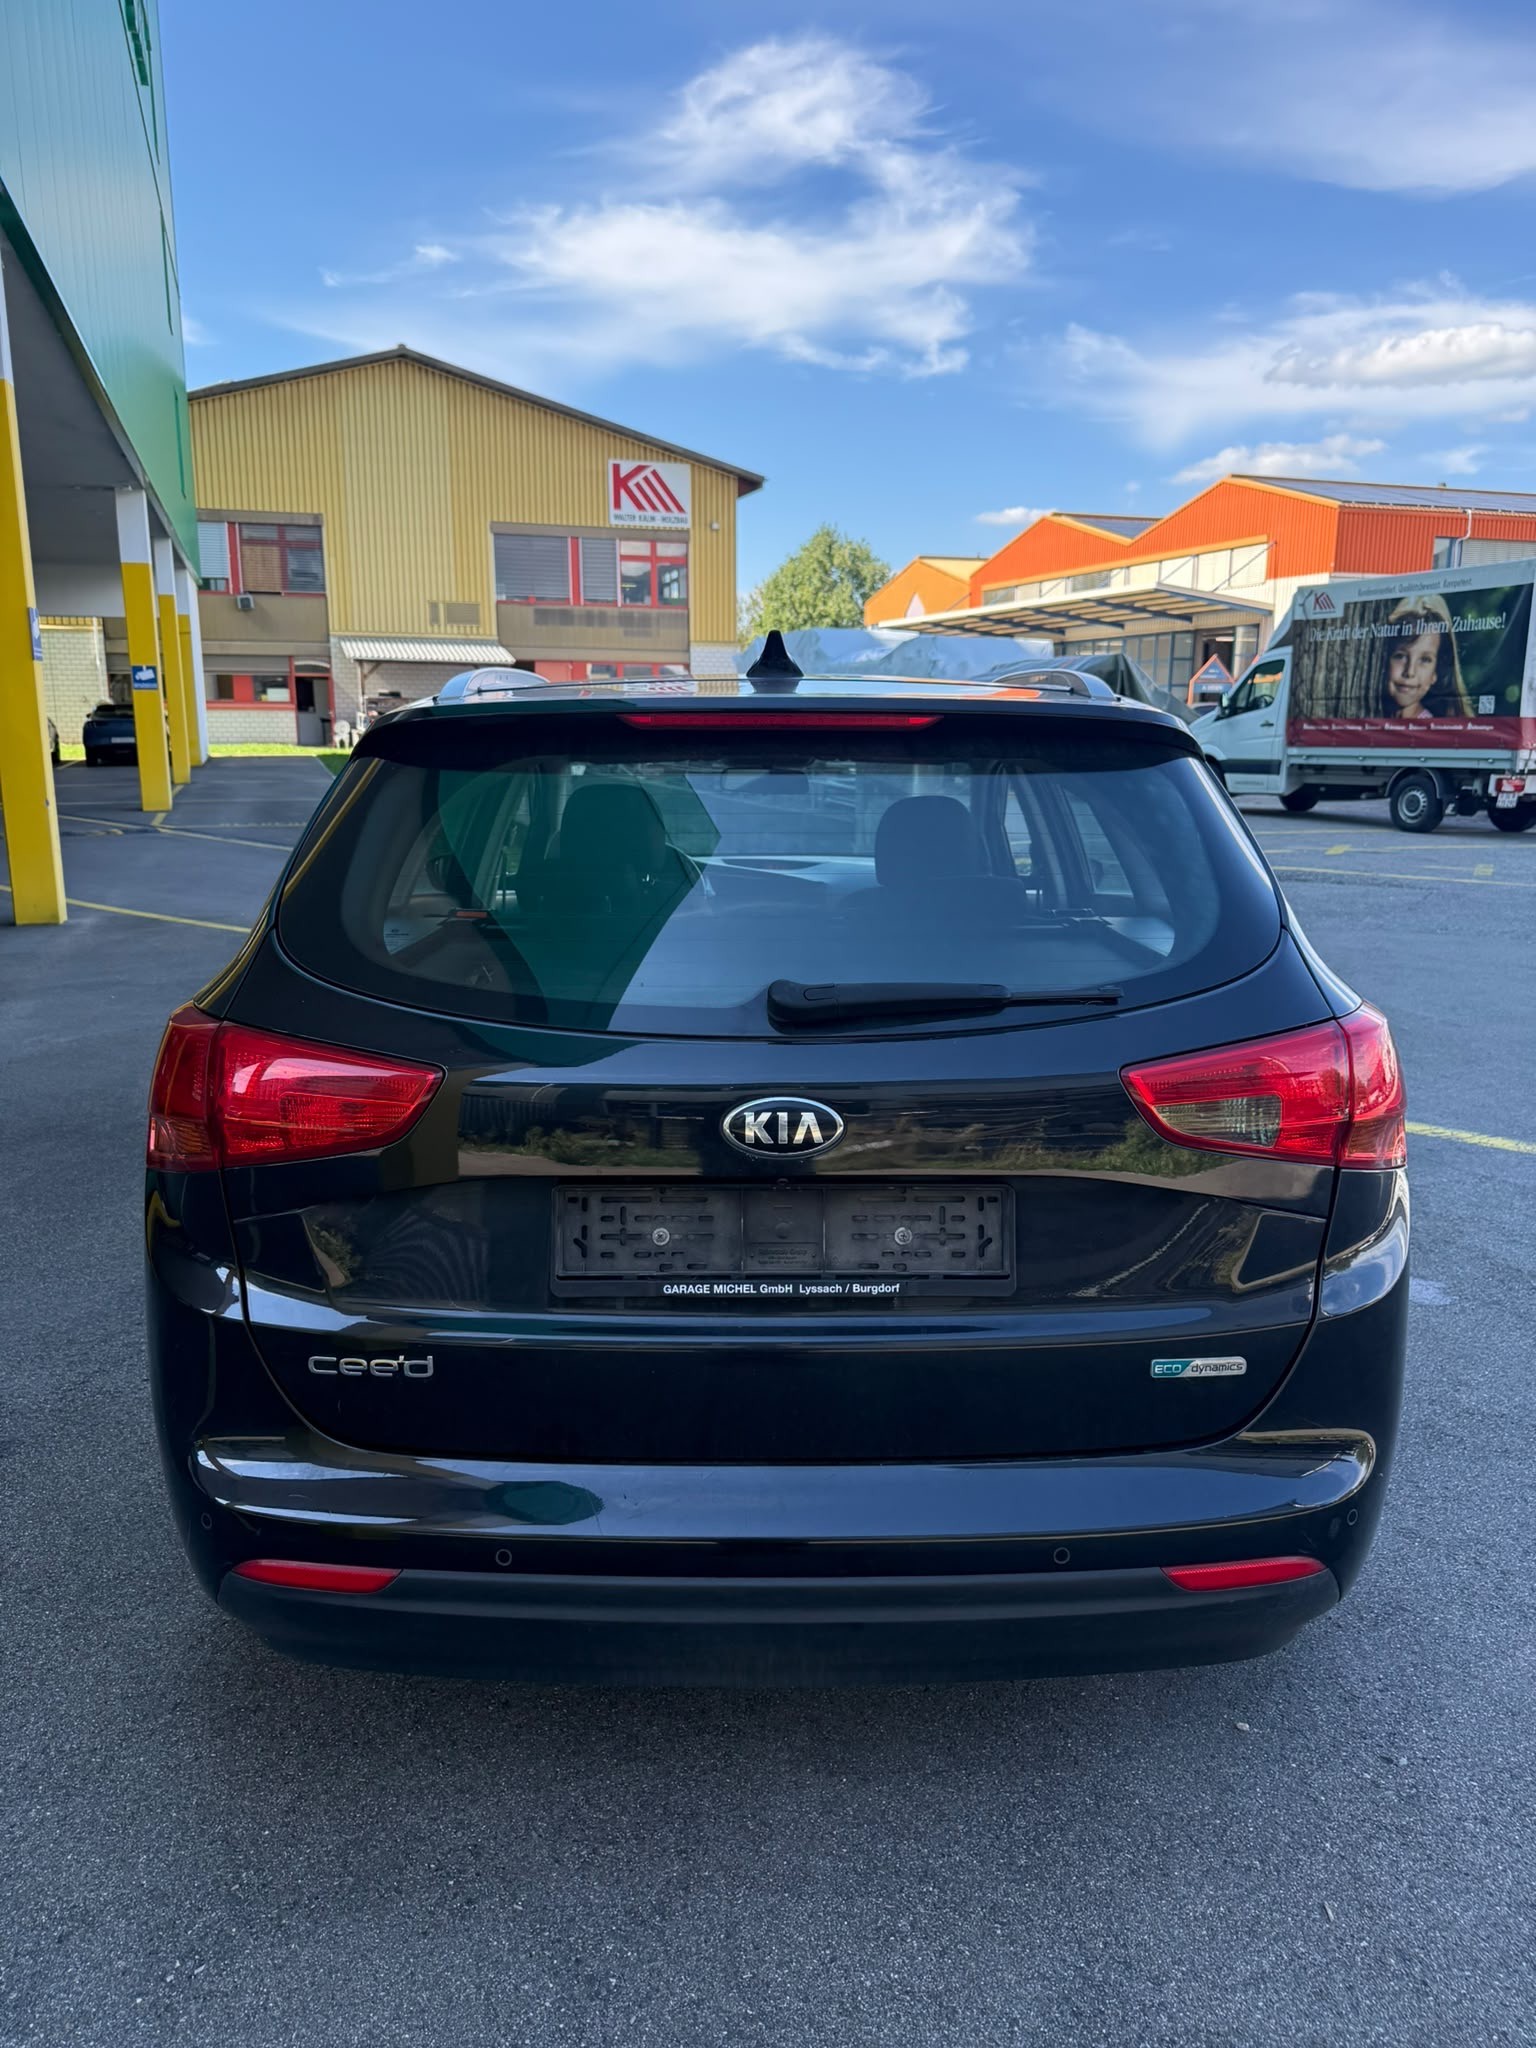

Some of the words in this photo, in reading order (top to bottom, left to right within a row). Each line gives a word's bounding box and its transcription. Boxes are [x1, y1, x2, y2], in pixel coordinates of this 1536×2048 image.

[1310, 627, 1325, 641] Die
[1326, 624, 1350, 641] Kraft
[1352, 623, 1368, 640] der
[1369, 623, 1400, 639] Natur
[1401, 620, 1413, 636] in
[1415, 618, 1449, 635] Ihrem
[1451, 612, 1506, 633] Zuhause!
[743, 1111, 824, 1145] KIA
[663, 1284, 710, 1294] GARAGE
[713, 1284, 757, 1294] MICHEL
[759, 1284, 793, 1294] GmbH
[799, 1283, 843, 1295] Lyssach
[852, 1282, 900, 1295] Burgdorf
[1191, 1362, 1243, 1375] dynamics
